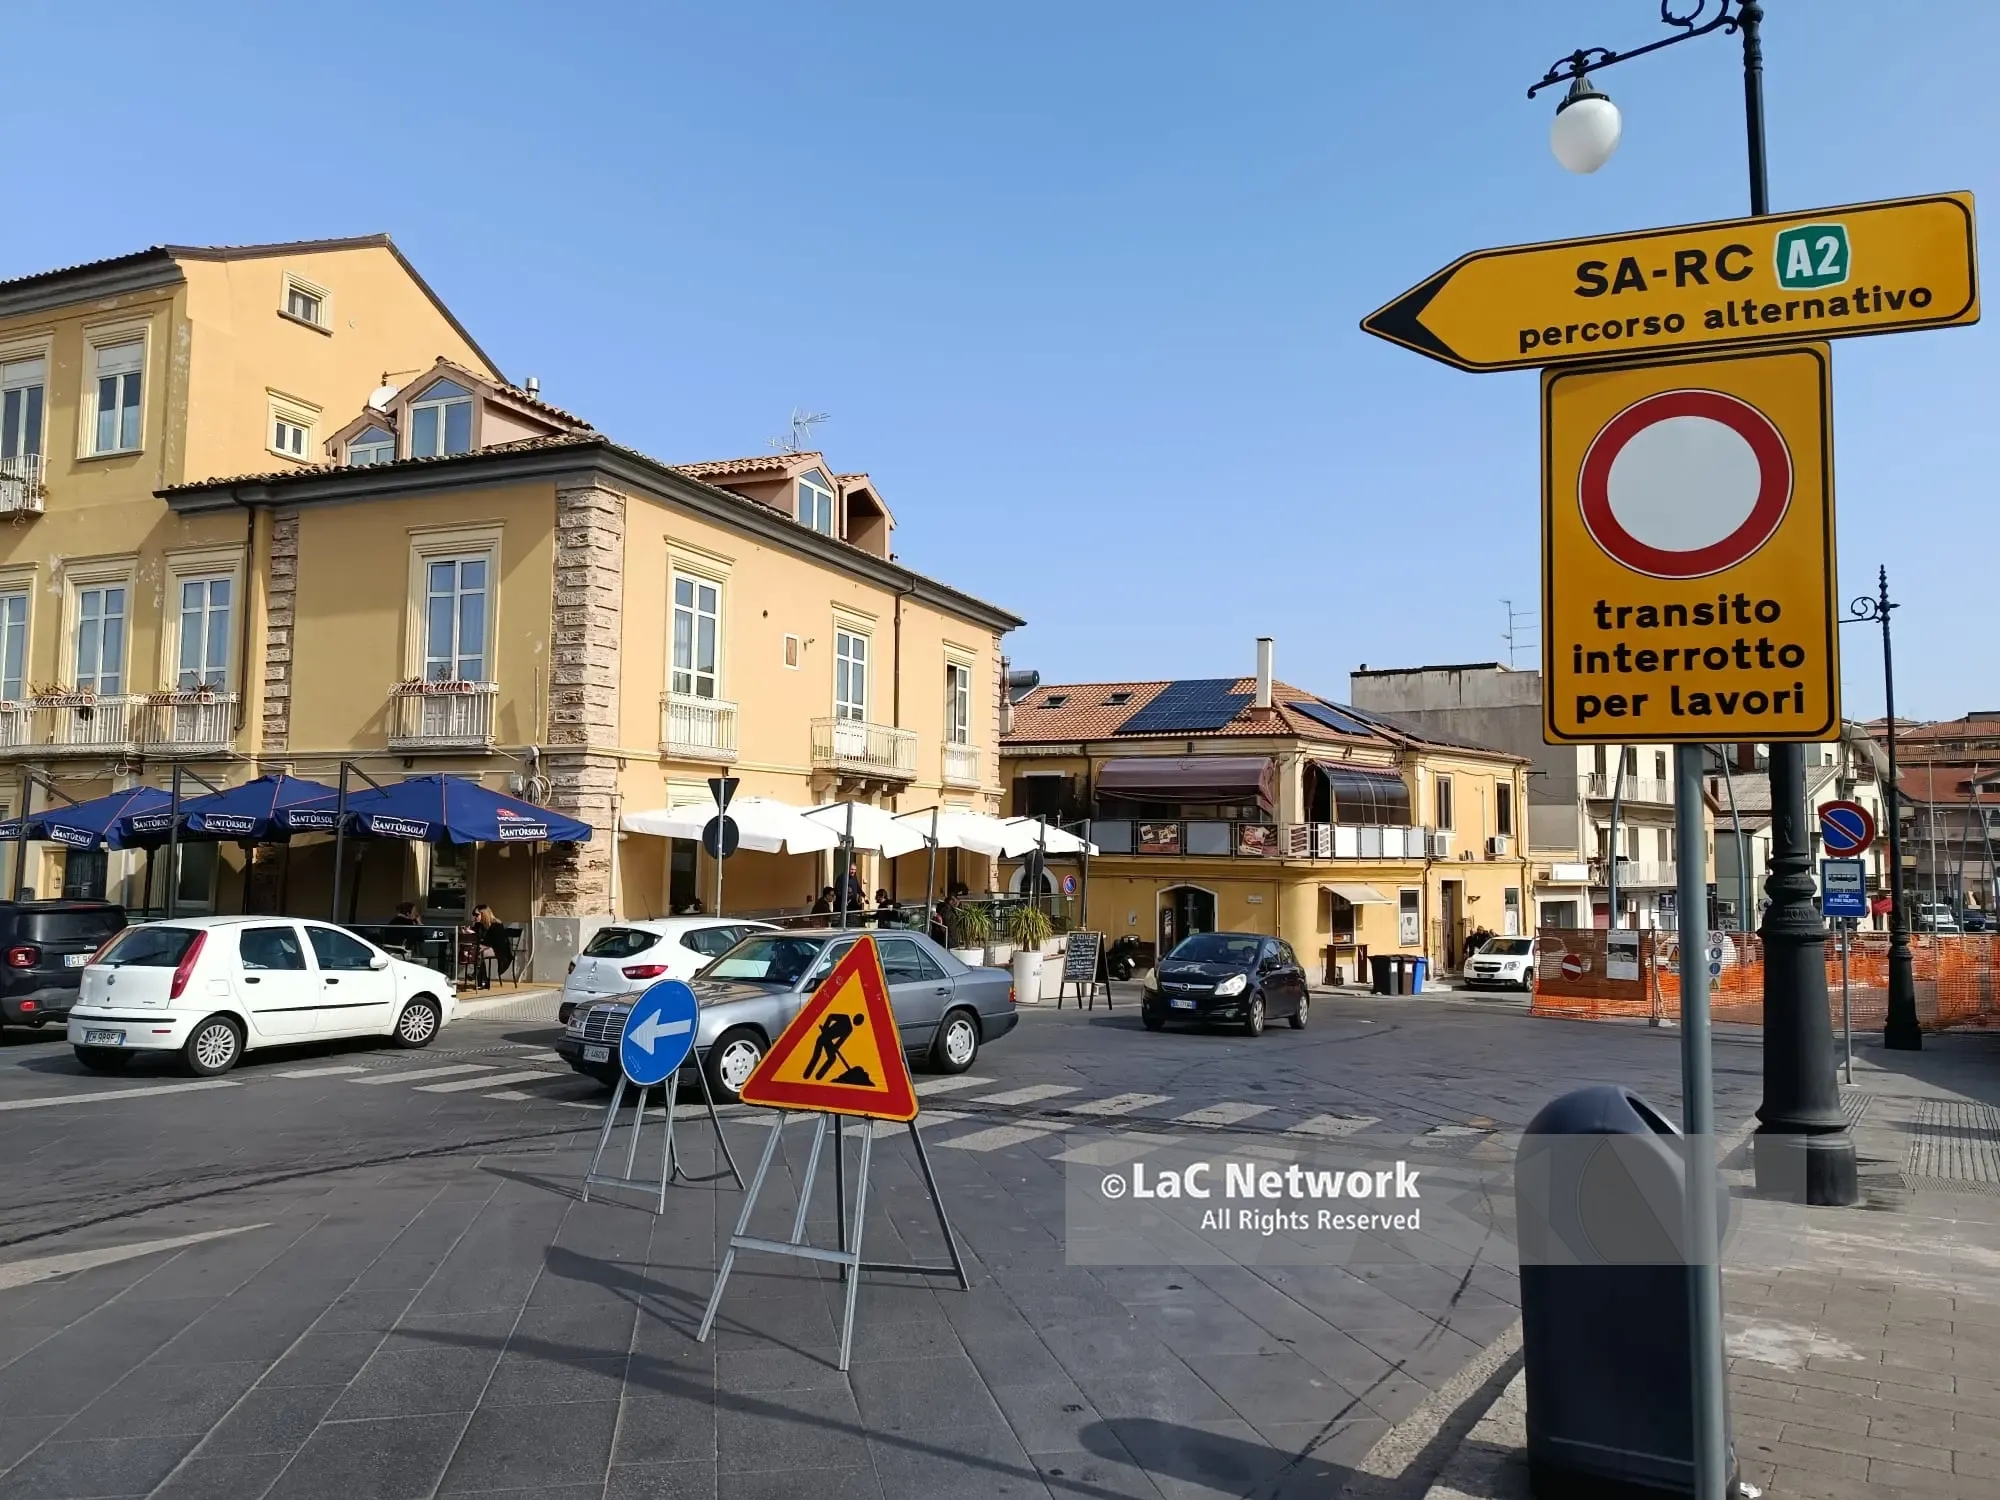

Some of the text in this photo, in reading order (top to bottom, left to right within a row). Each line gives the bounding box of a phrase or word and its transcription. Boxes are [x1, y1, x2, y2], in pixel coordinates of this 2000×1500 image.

[1574, 234, 1843, 297] SA-RC A2
[1519, 284, 1933, 354] percorso alternativo
[1593, 592, 1782, 630] transito
[1572, 639, 1806, 674] interrotto
[1576, 681, 1805, 725] per lavori
